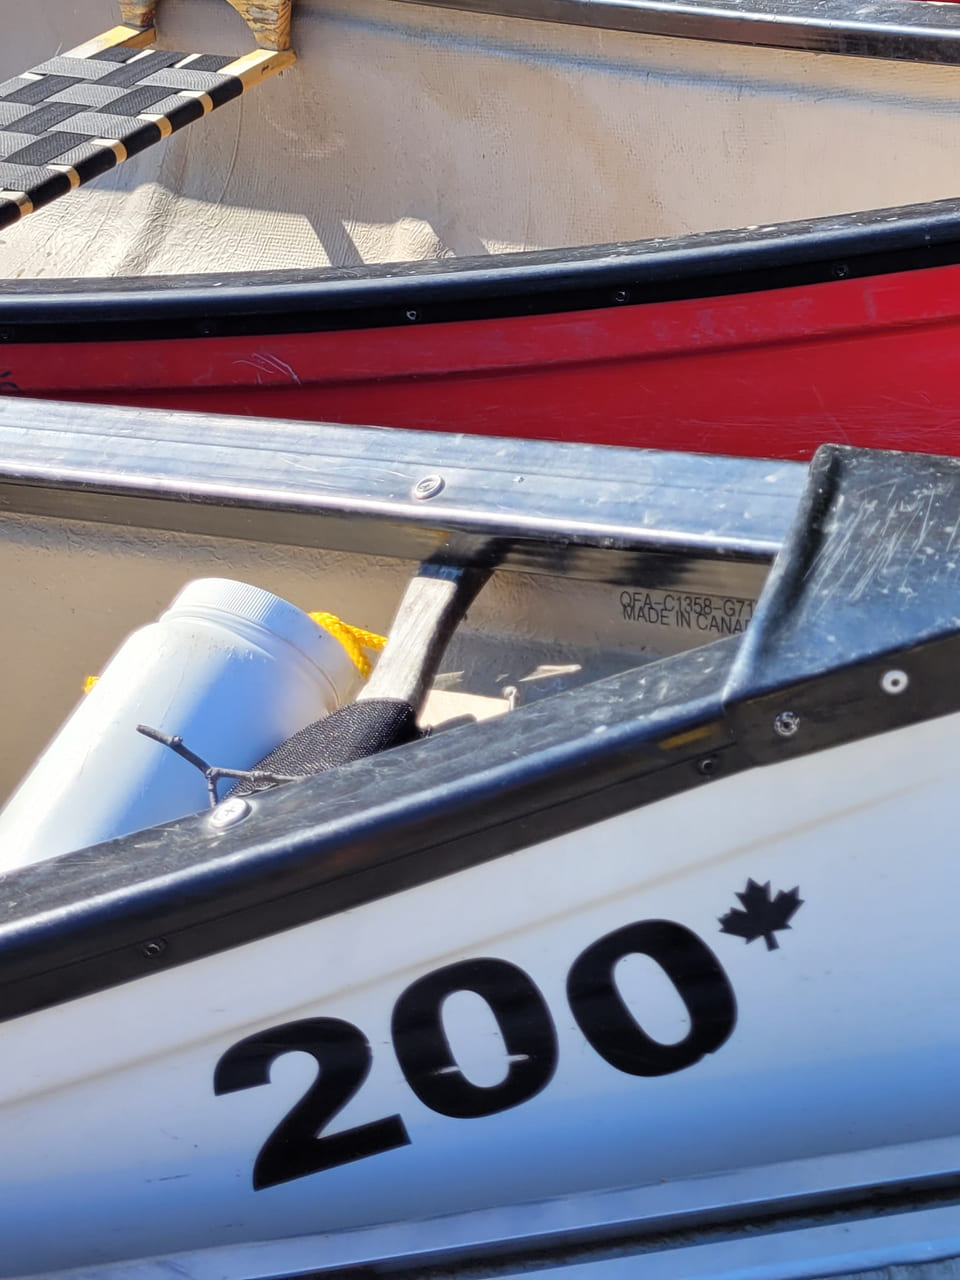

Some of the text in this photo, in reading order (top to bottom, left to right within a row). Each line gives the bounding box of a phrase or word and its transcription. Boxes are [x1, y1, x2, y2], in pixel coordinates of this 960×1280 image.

[622, 604, 671, 626] MADE
[675, 612, 691, 629] IN
[213, 918, 738, 1191] 200
